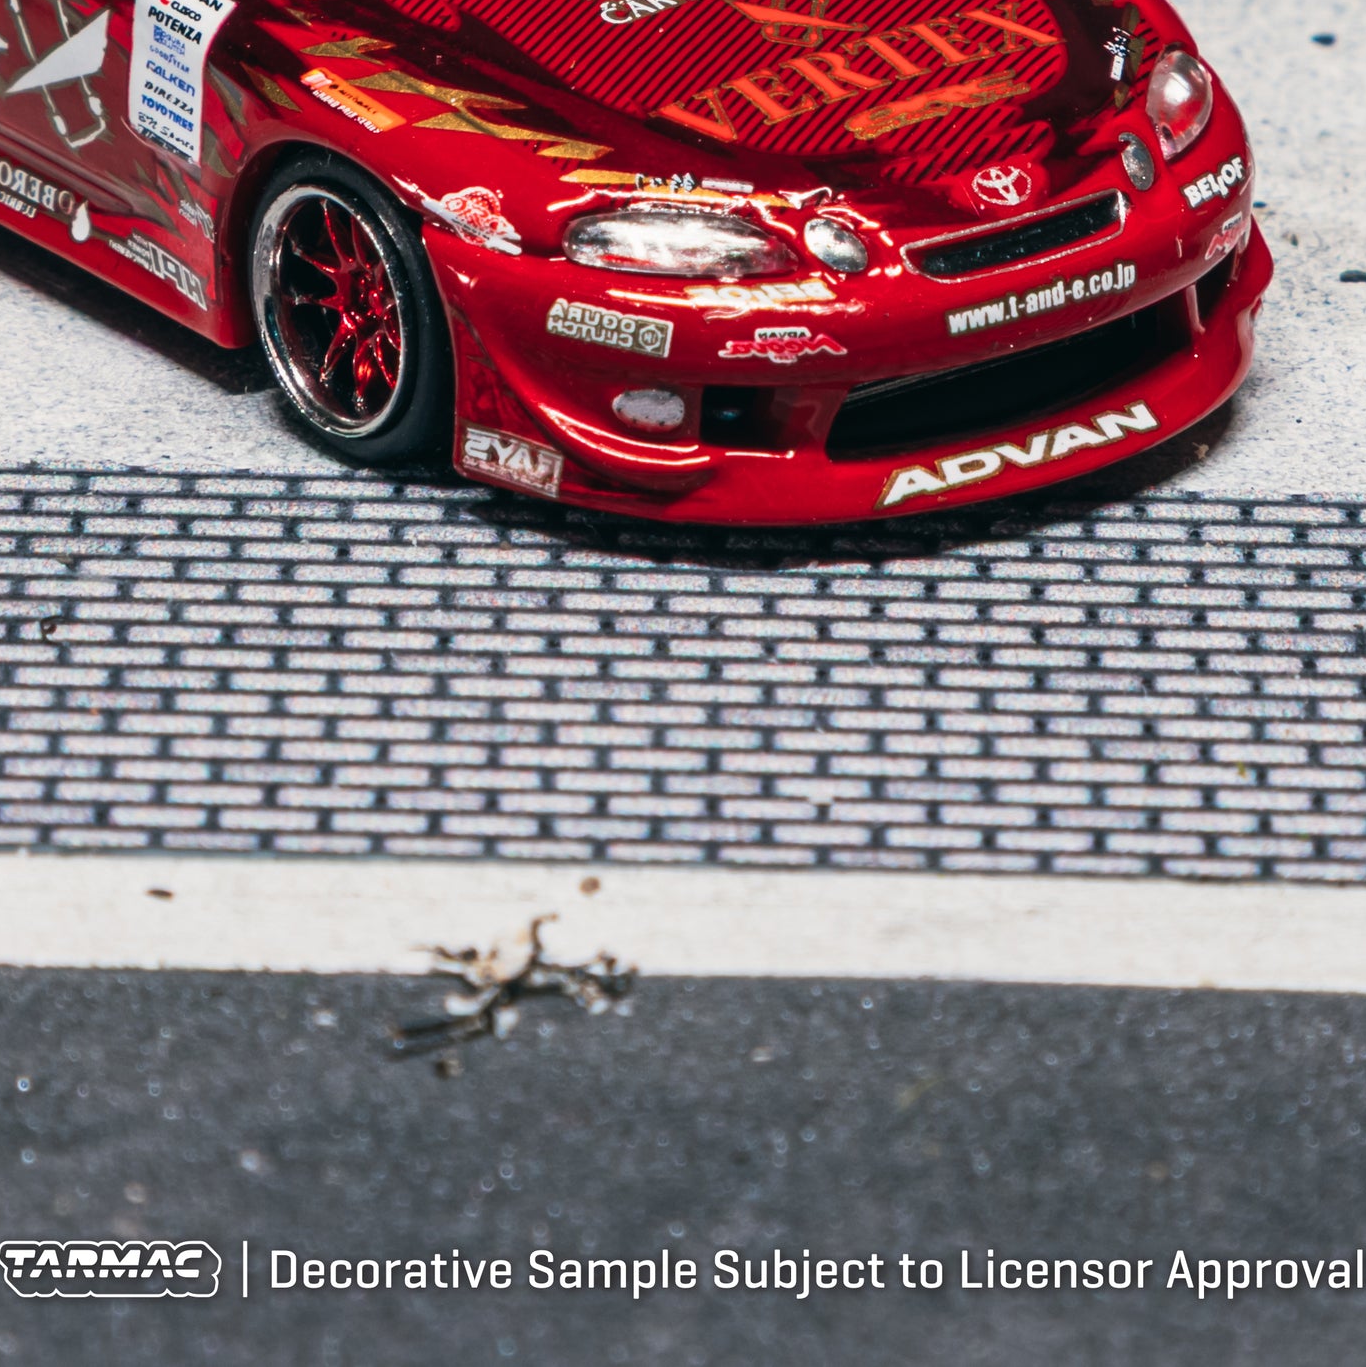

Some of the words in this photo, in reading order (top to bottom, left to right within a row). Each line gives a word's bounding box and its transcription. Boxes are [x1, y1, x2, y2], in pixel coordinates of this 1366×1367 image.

[147, 5, 202, 45] POTENZA
[145, 59, 195, 98] FALKEN
[649, 2, 1066, 142] VERTEX
[141, 94, 169, 116] TOYO
[946, 262, 1137, 335] www.t-and-e.co.jp
[880, 402, 1159, 508] ADVAN
